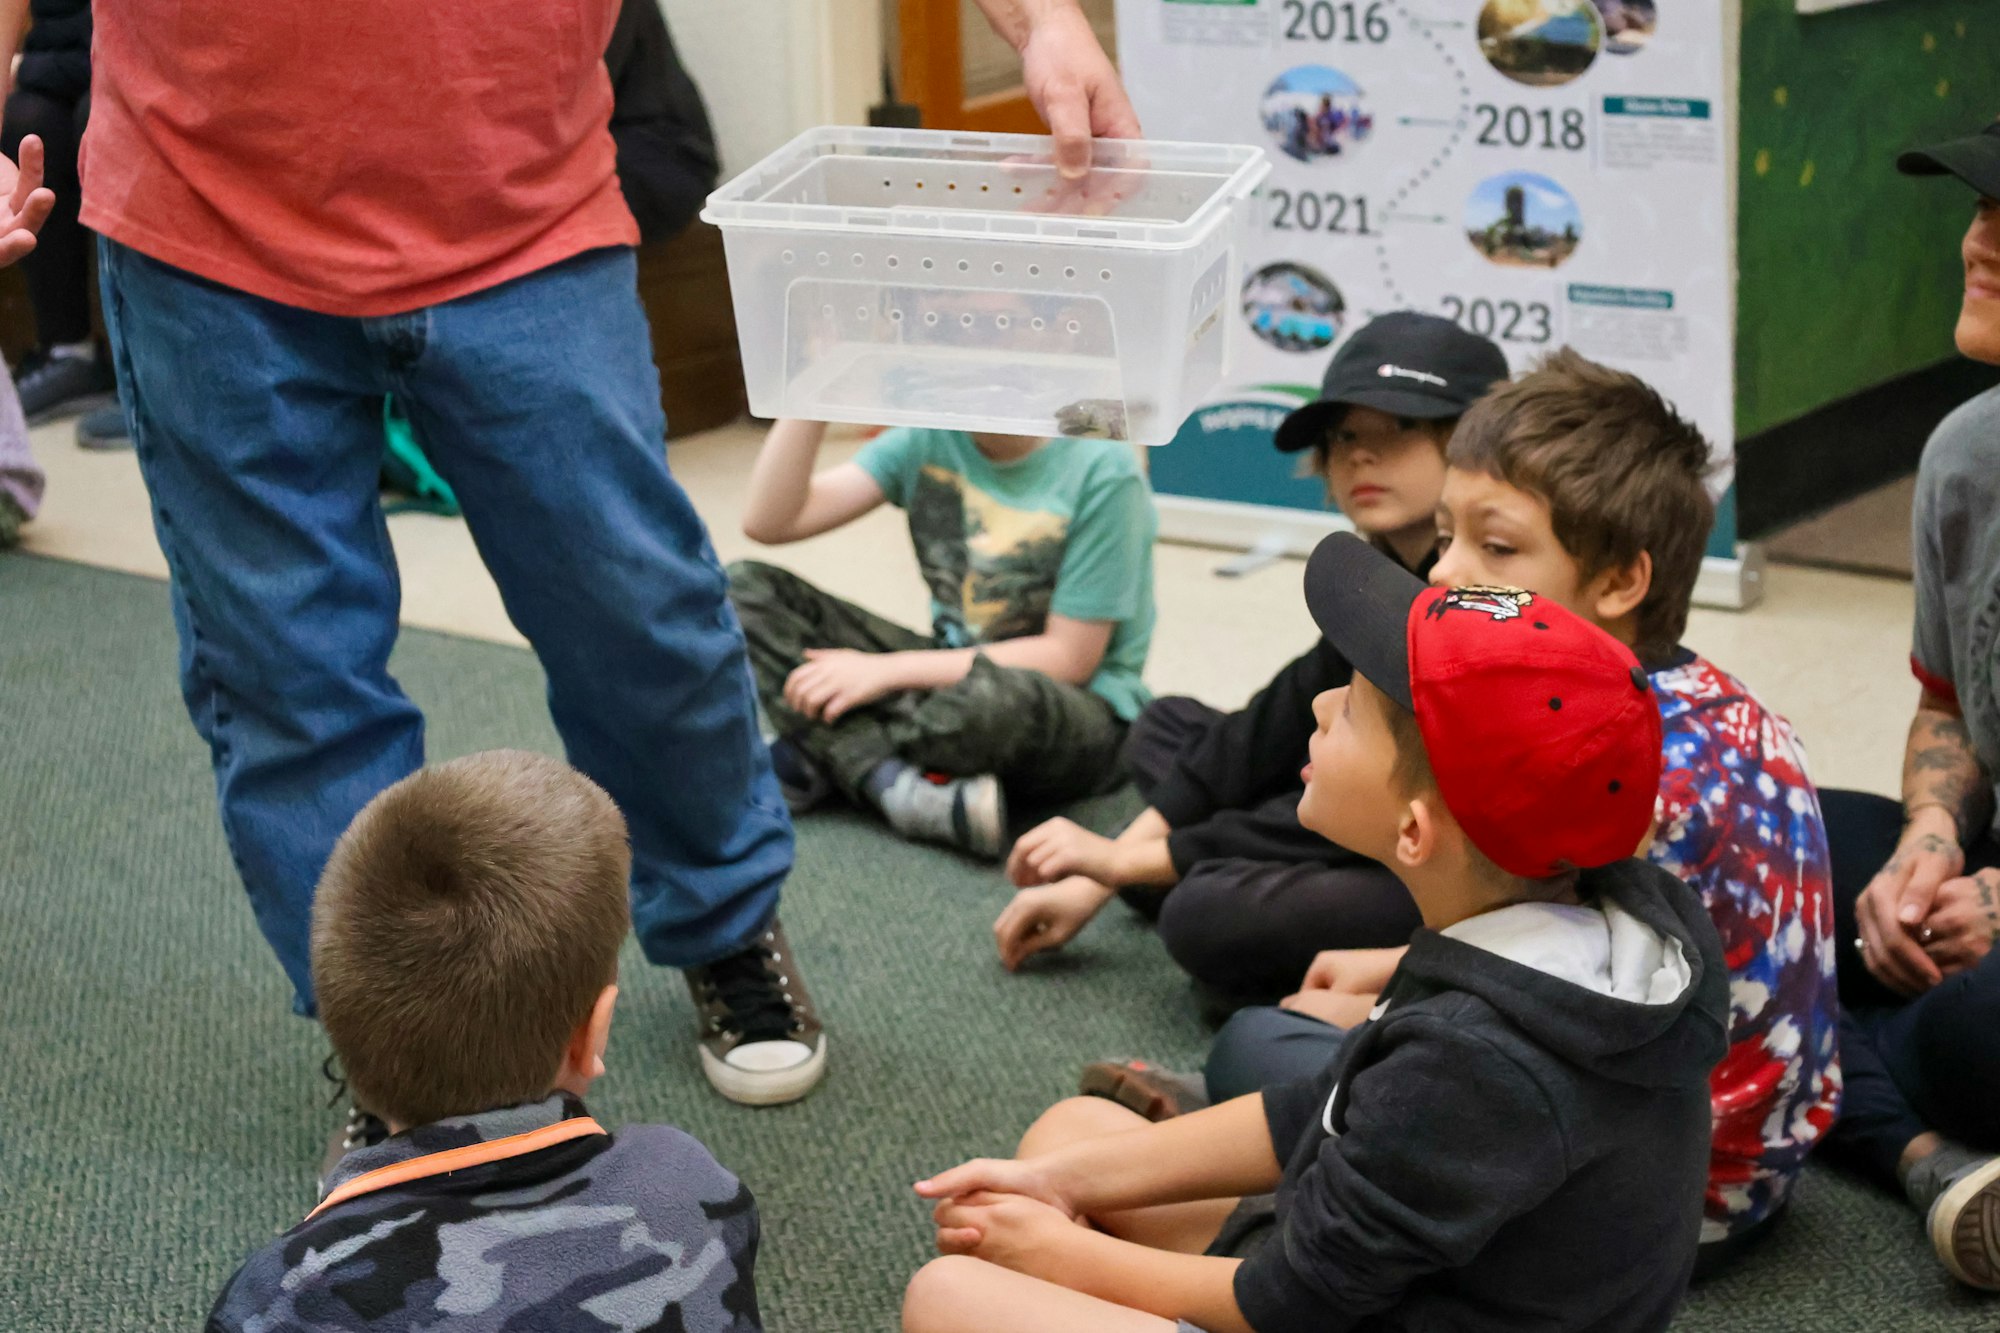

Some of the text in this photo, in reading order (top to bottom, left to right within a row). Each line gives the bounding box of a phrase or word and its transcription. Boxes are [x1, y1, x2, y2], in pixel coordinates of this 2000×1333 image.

[1282, 0, 1390, 43] 2016
[1475, 104, 1585, 150] 2018
[1269, 188, 1370, 235] 2021
[1441, 294, 1551, 343] 2023
